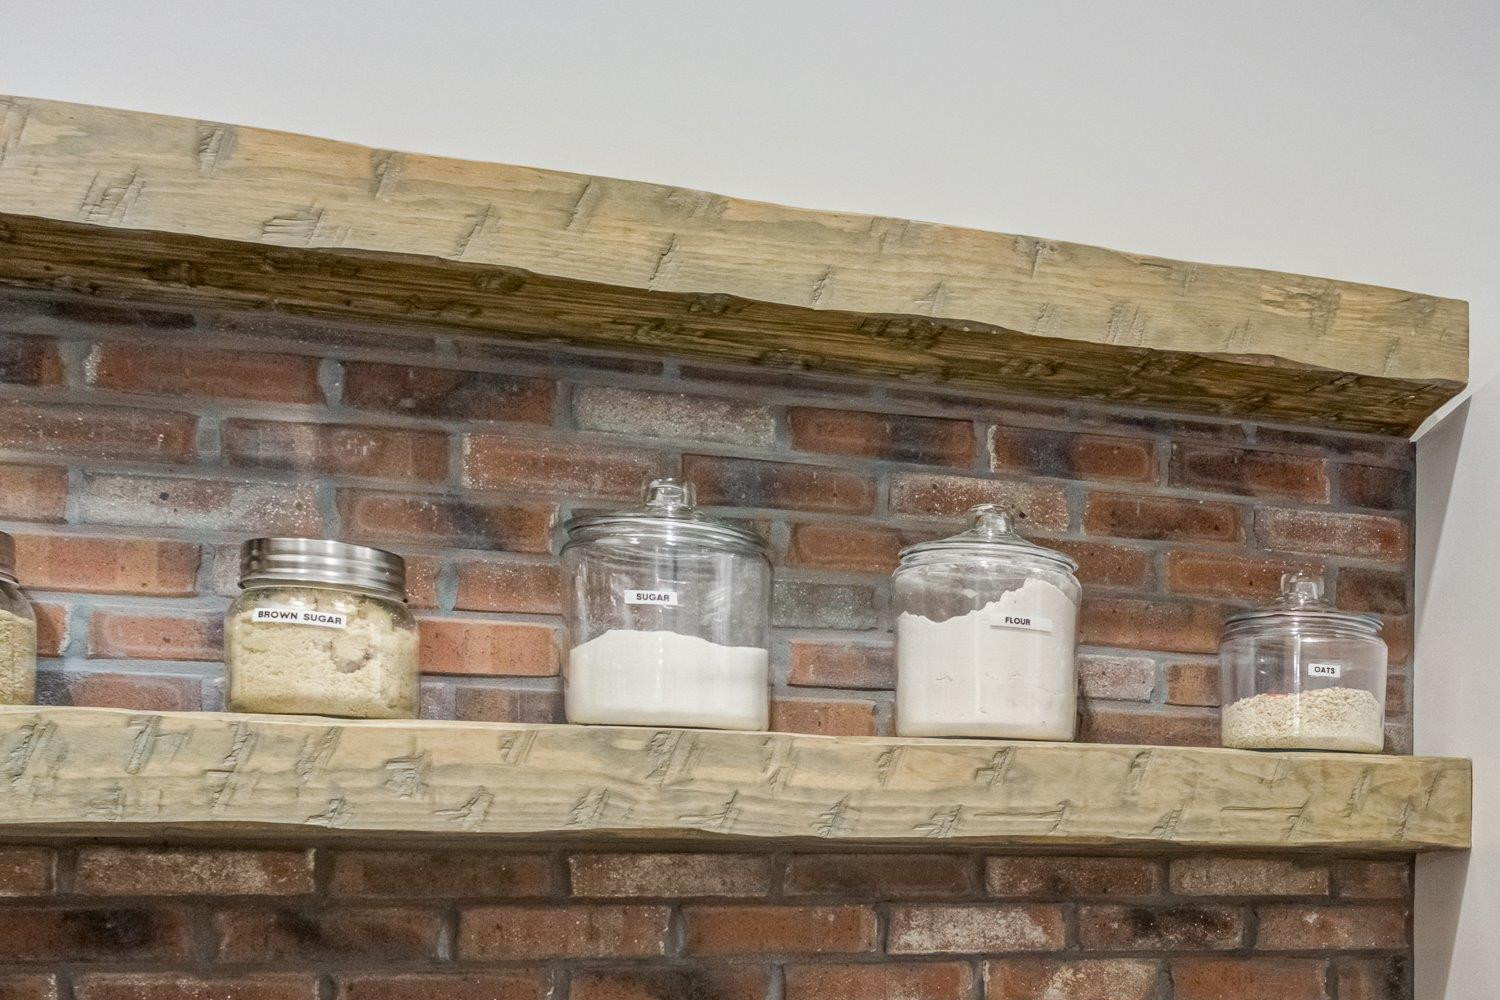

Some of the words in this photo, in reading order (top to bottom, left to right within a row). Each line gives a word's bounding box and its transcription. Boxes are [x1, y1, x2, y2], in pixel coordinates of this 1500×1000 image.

[636, 593, 670, 602] SUGAR
[257, 610, 298, 621] BROWN
[303, 613, 342, 626] SUGAR
[1005, 617, 1031, 626] FLOUR
[1314, 666, 1336, 675] OATS
